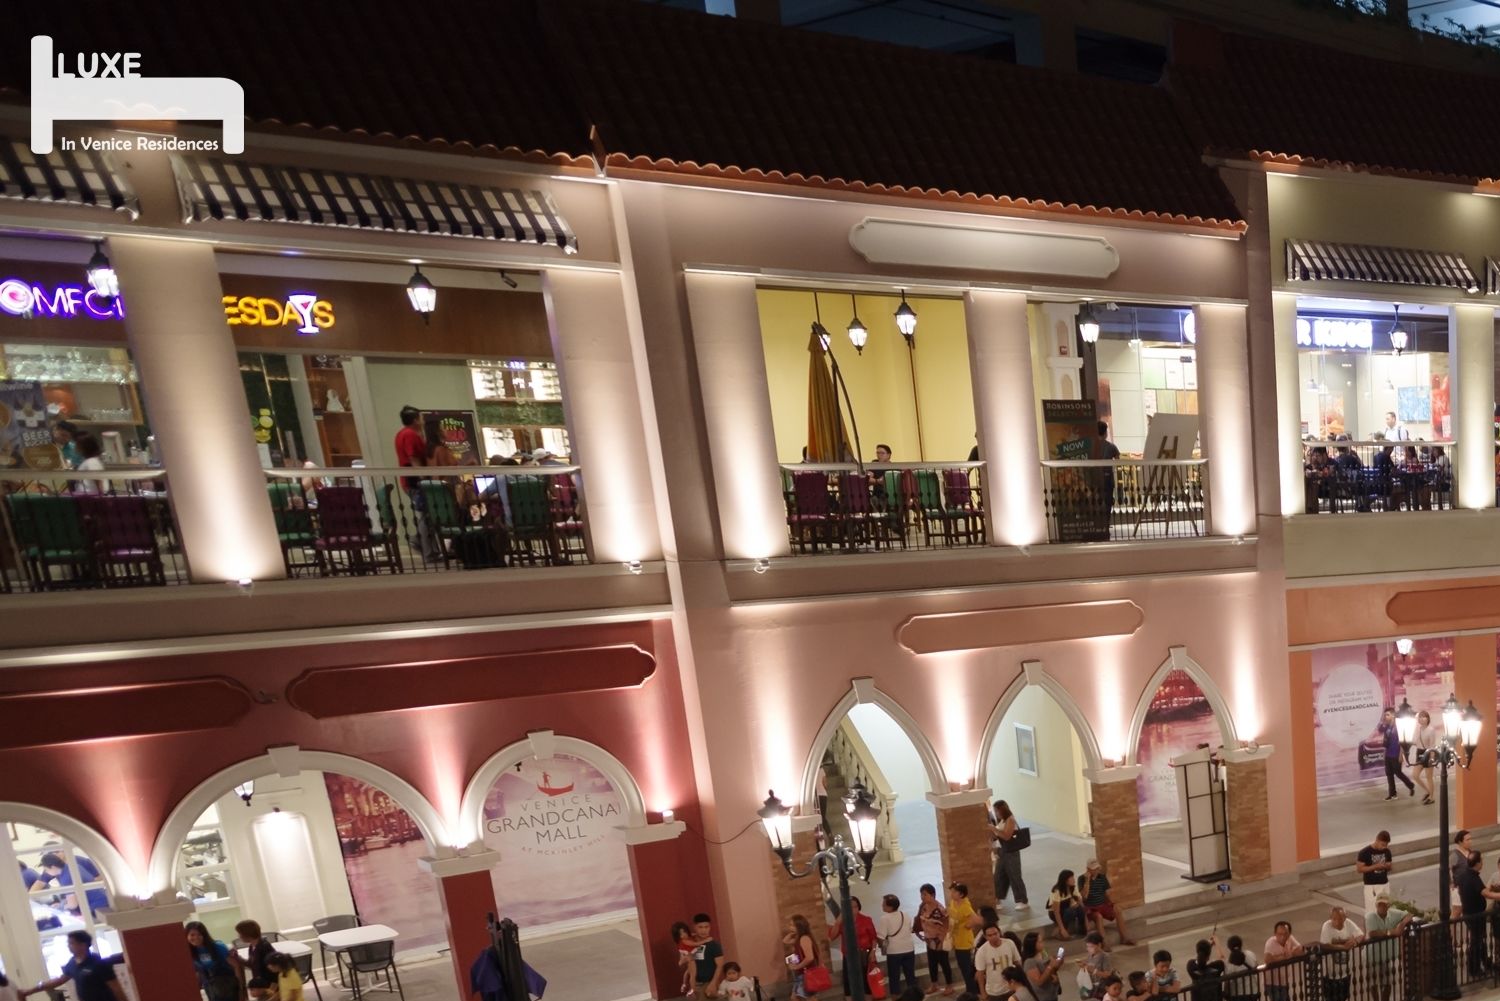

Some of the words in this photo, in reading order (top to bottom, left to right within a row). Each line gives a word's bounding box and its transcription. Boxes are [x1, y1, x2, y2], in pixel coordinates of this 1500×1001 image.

[1046, 402, 1091, 410] ROBINSONS
[1062, 441, 1085, 453] NOW
[521, 793, 592, 812] VENICE
[535, 825, 588, 845] MALL
